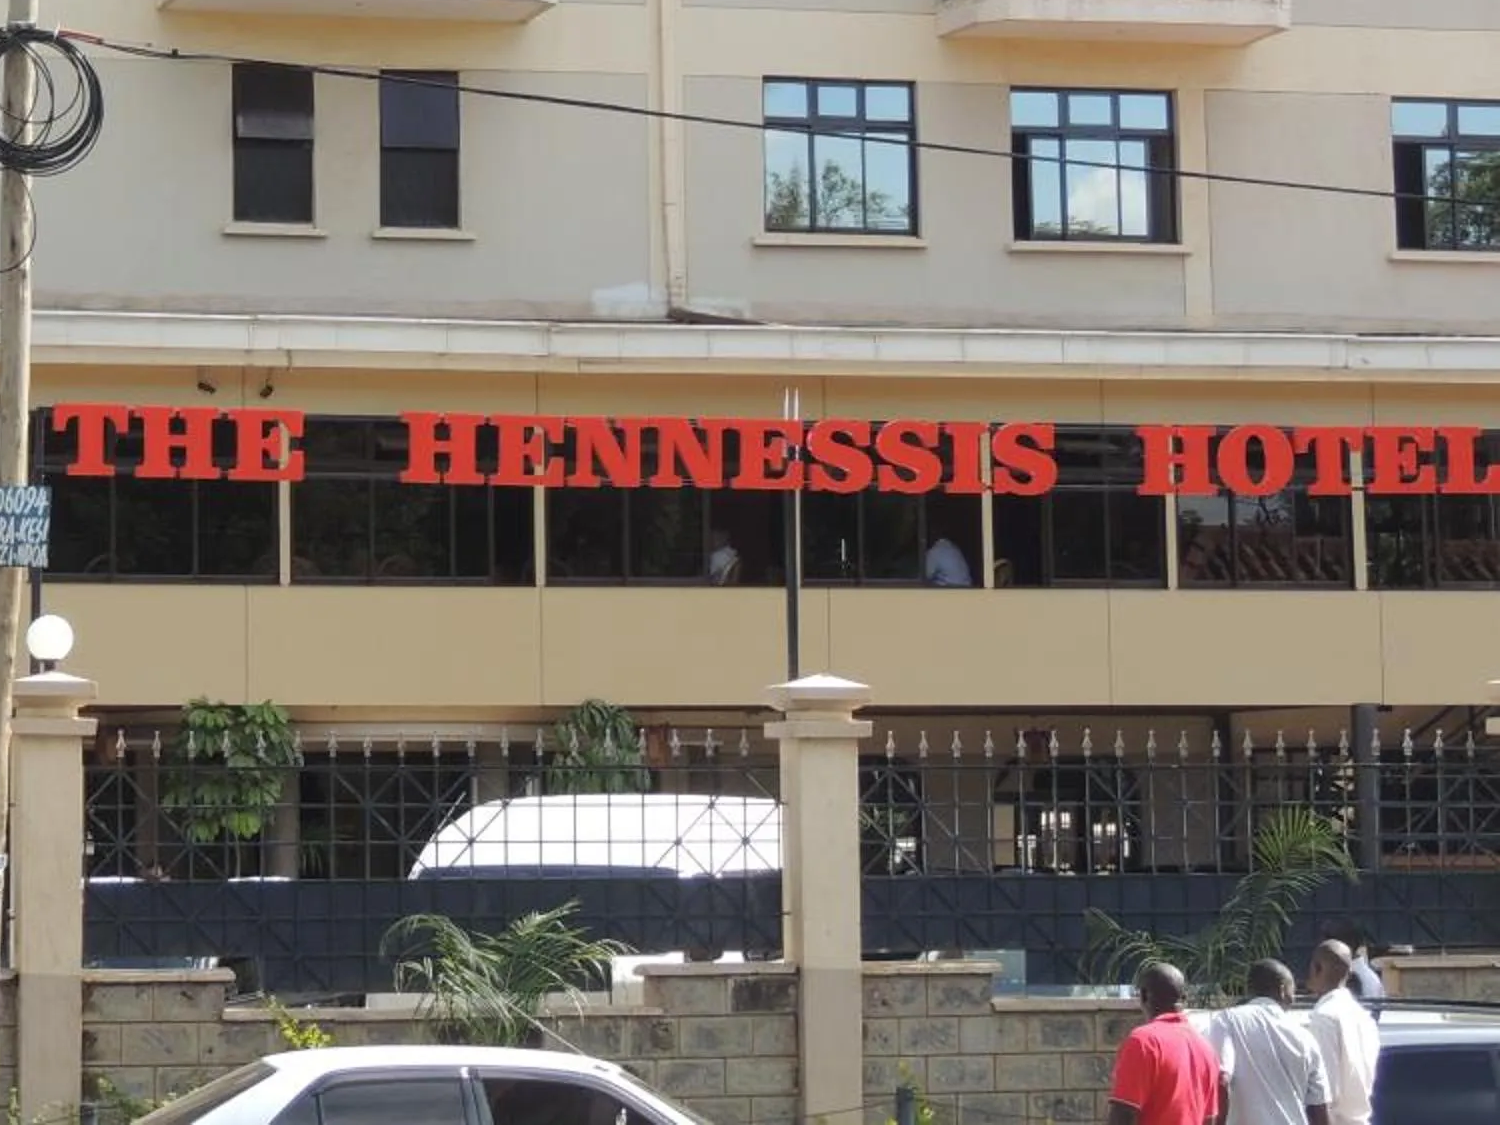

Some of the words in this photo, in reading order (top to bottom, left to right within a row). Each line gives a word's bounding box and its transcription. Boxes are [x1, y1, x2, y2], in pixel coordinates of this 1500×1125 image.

[53, 403, 304, 481] THE
[401, 412, 1057, 495] HENNESSIS
[1137, 426, 1500, 495] HOTEL
